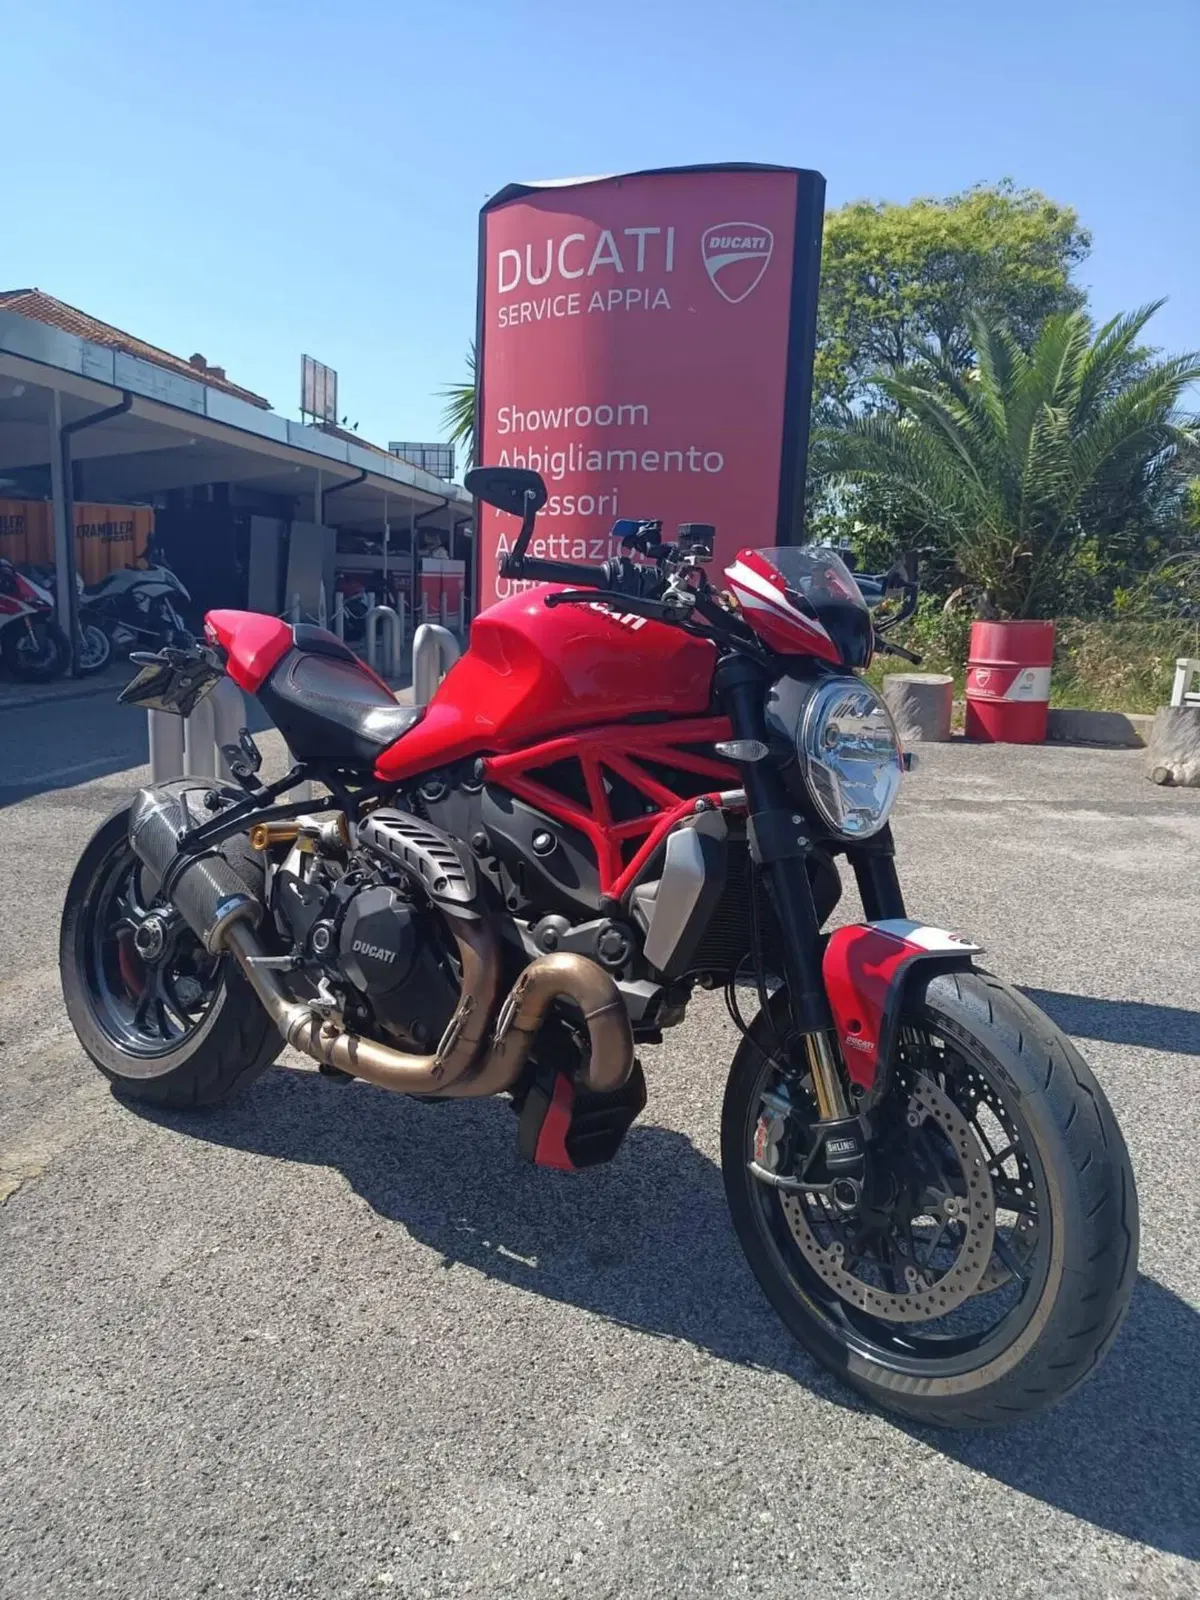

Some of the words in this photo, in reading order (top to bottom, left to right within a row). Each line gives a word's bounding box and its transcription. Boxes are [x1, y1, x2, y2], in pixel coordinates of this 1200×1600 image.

[708, 236, 767, 250] DUCATI
[498, 226, 675, 293] DUCATI
[497, 293, 581, 328] SERVICE
[587, 287, 672, 313] APPIA
[496, 403, 649, 435] Showroom
[497, 442, 725, 481] Abbigliamento
[495, 488, 619, 518] ssori
[74, 521, 134, 539] CRAMBLER
[352, 940, 396, 963] DUCATI
